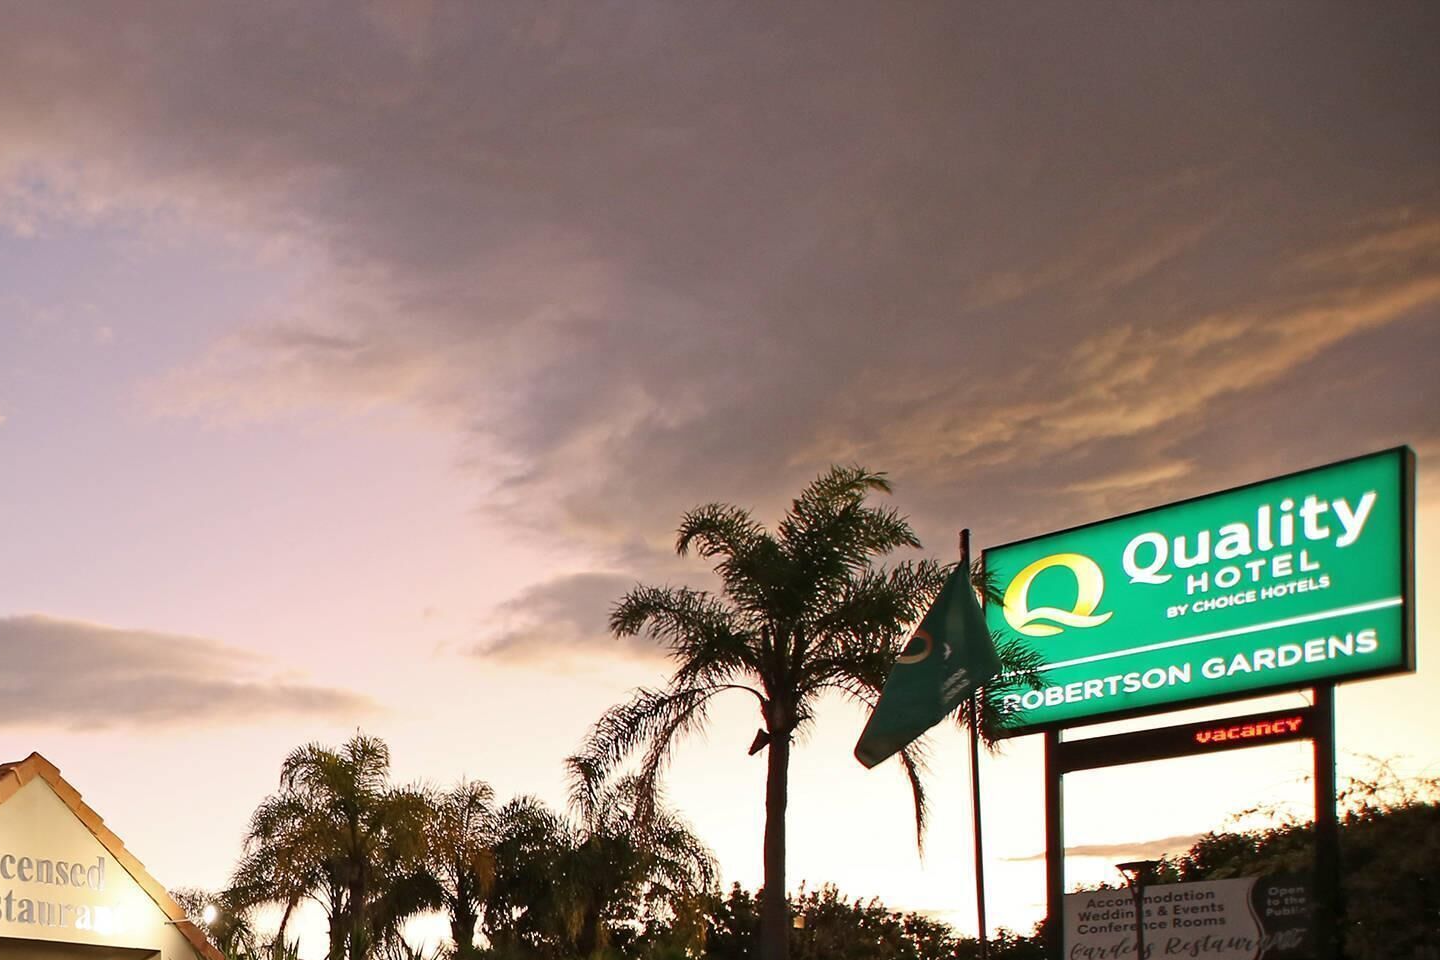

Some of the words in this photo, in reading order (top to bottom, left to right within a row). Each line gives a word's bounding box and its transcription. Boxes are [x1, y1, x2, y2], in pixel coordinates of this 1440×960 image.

[1122, 490, 1377, 585] Quality
[1187, 549, 1320, 595] HOTEL
[1002, 553, 1113, 637] Q
[1166, 604, 1189, 619] BY
[1192, 591, 1257, 614] CHOICE
[1261, 576, 1331, 600] HOTELS
[1001, 663, 1191, 715] ROBERTSON
[1201, 629, 1378, 679] GARDENS
[1195, 715, 1304, 745] vacancy
[1267, 887, 1305, 897] Open
[1283, 896, 1306, 905] the
[1077, 908, 1152, 922] Weddins
[1157, 906, 1169, 916] &
[1174, 902, 1225, 916] Events
[1173, 914, 1226, 928] Rooms
